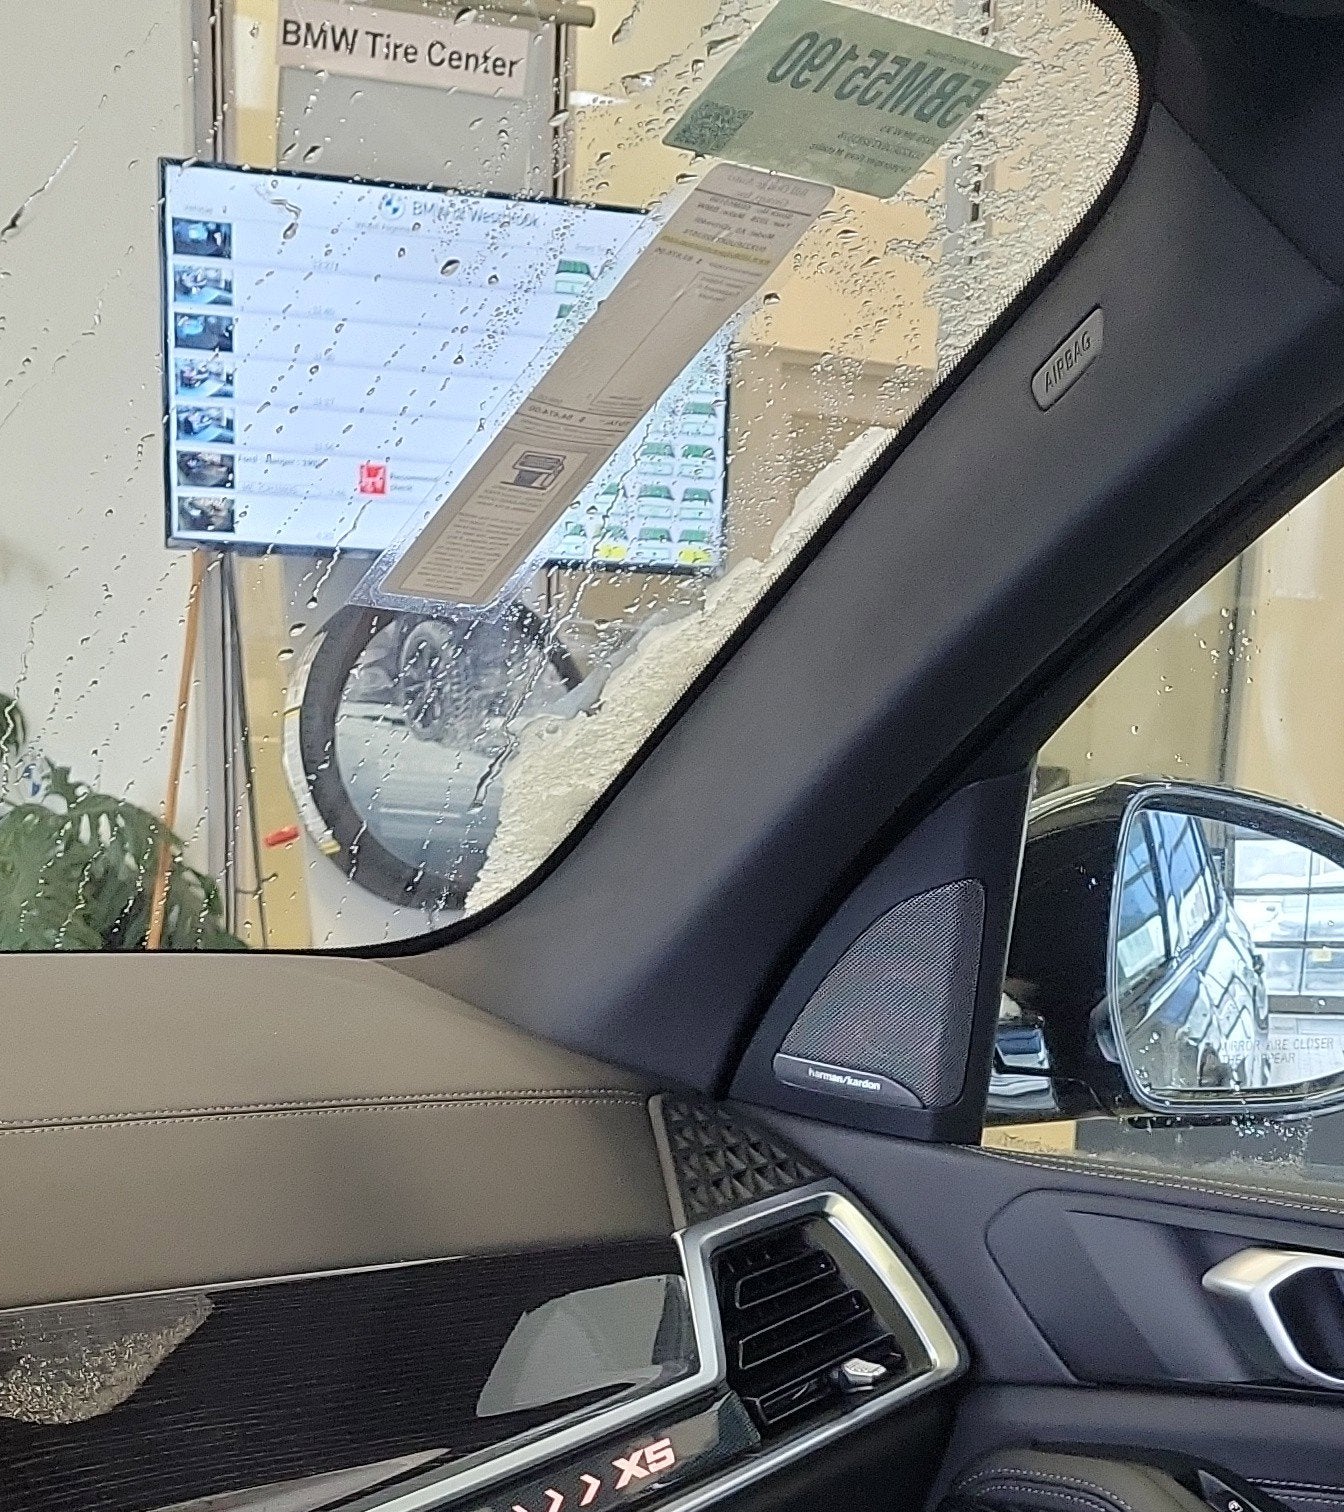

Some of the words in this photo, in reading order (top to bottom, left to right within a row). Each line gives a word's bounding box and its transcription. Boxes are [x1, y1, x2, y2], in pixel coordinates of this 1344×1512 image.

[282, 19, 359, 55] BMW
[365, 31, 418, 64] Tire
[428, 41, 524, 77] Center
[1044, 331, 1091, 393] AIRBAG
[1293, 1037, 1334, 1050] CLOSER
[808, 1067, 881, 1091] harman/kardon
[611, 1437, 676, 1490] X5
